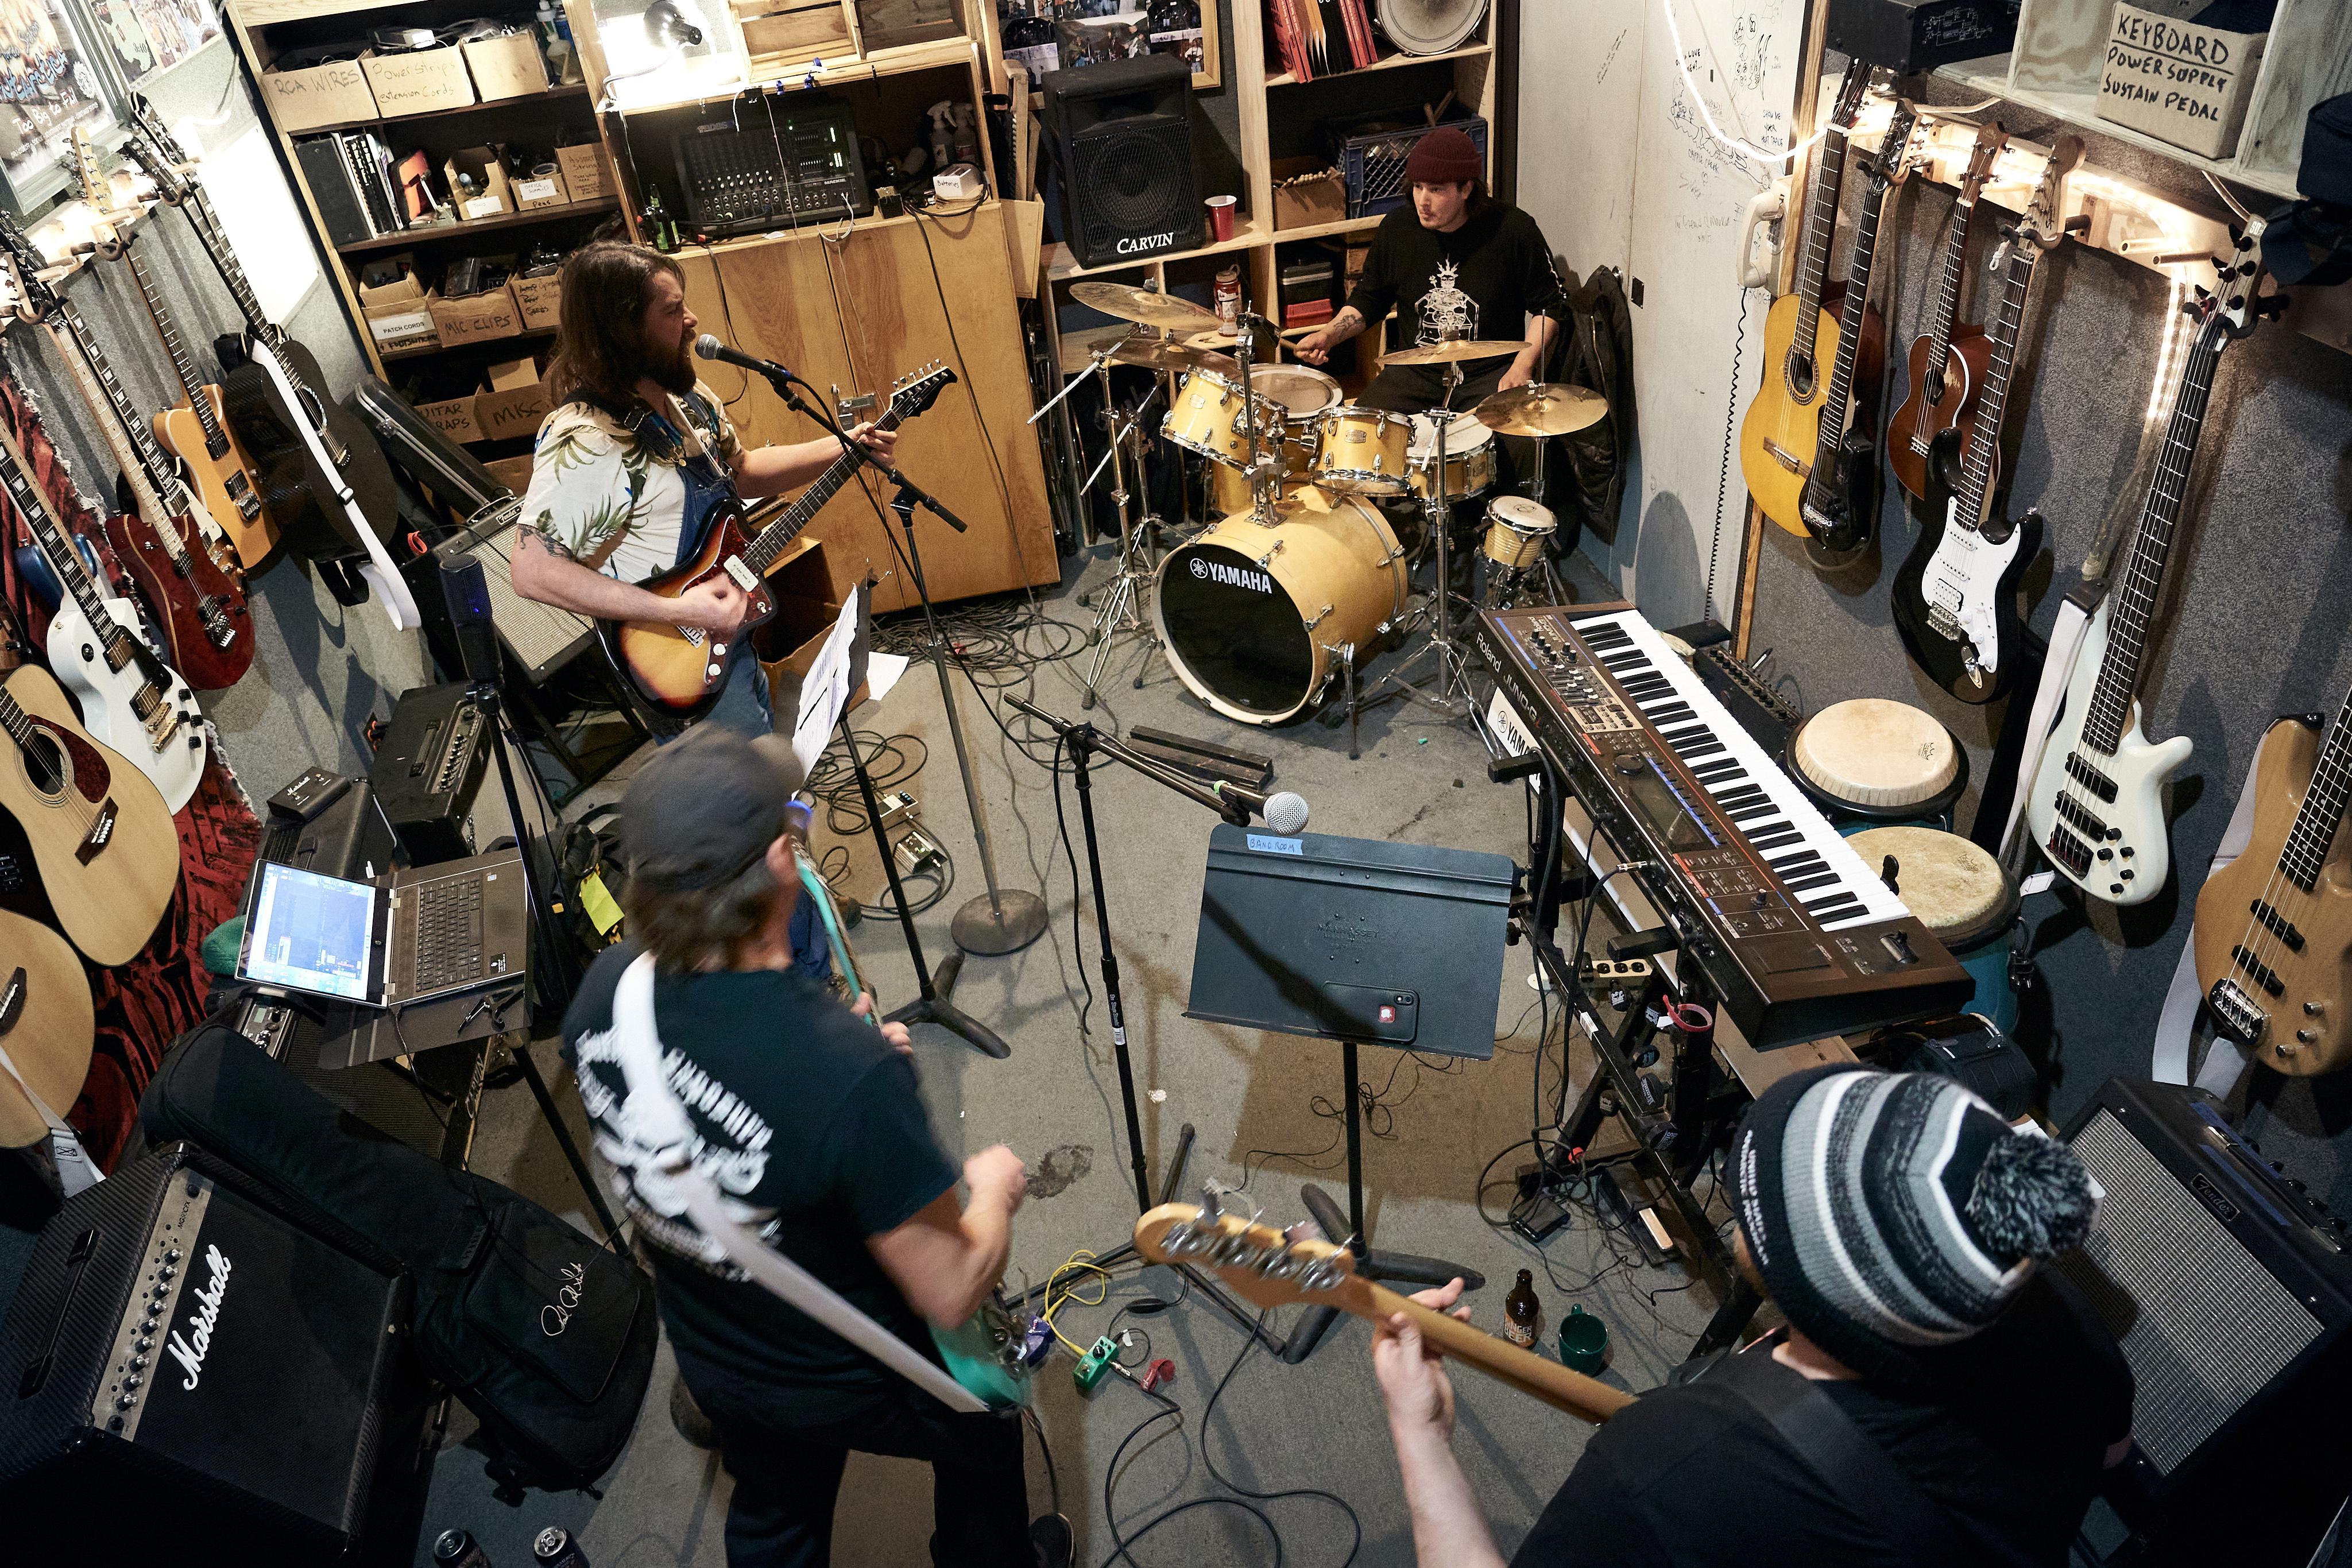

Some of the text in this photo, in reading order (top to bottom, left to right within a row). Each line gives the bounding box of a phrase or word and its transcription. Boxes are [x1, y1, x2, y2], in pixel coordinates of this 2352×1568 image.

[2118, 13, 2229, 65] KEYBOARD
[1688, 48, 1701, 58] LOVE
[373, 60, 456, 79] Power Strips
[2107, 47, 2227, 93] POWER SUPPLY
[274, 69, 360, 96] RCA WIRES
[379, 84, 454, 103] extension Cords
[2103, 72, 2218, 121] SUSTAIN PEDAL
[13, 117, 34, 135] Too
[32, 106, 52, 127] Big
[49, 101, 62, 116] to
[1763, 109, 1774, 118] SHOW
[1764, 124, 1777, 132] YOUR
[1688, 148, 1704, 165] CRIPPLE
[937, 179, 960, 188] Batteries
[1116, 232, 1174, 254] CARVIN
[383, 321, 425, 334] PATCH CORDS
[444, 315, 510, 336] MIC CLIPS
[421, 403, 463, 419] UITAR
[493, 400, 542, 427] MISC
[1208, 562, 1272, 594] YAMAHA
[1477, 632, 1502, 673] Roland
[287, 776, 310, 796] Marshall
[1250, 839, 1295, 853] BAND ROOM
[2199, 1179, 2233, 1215] Fender
[167, 1244, 232, 1391] Marshall
